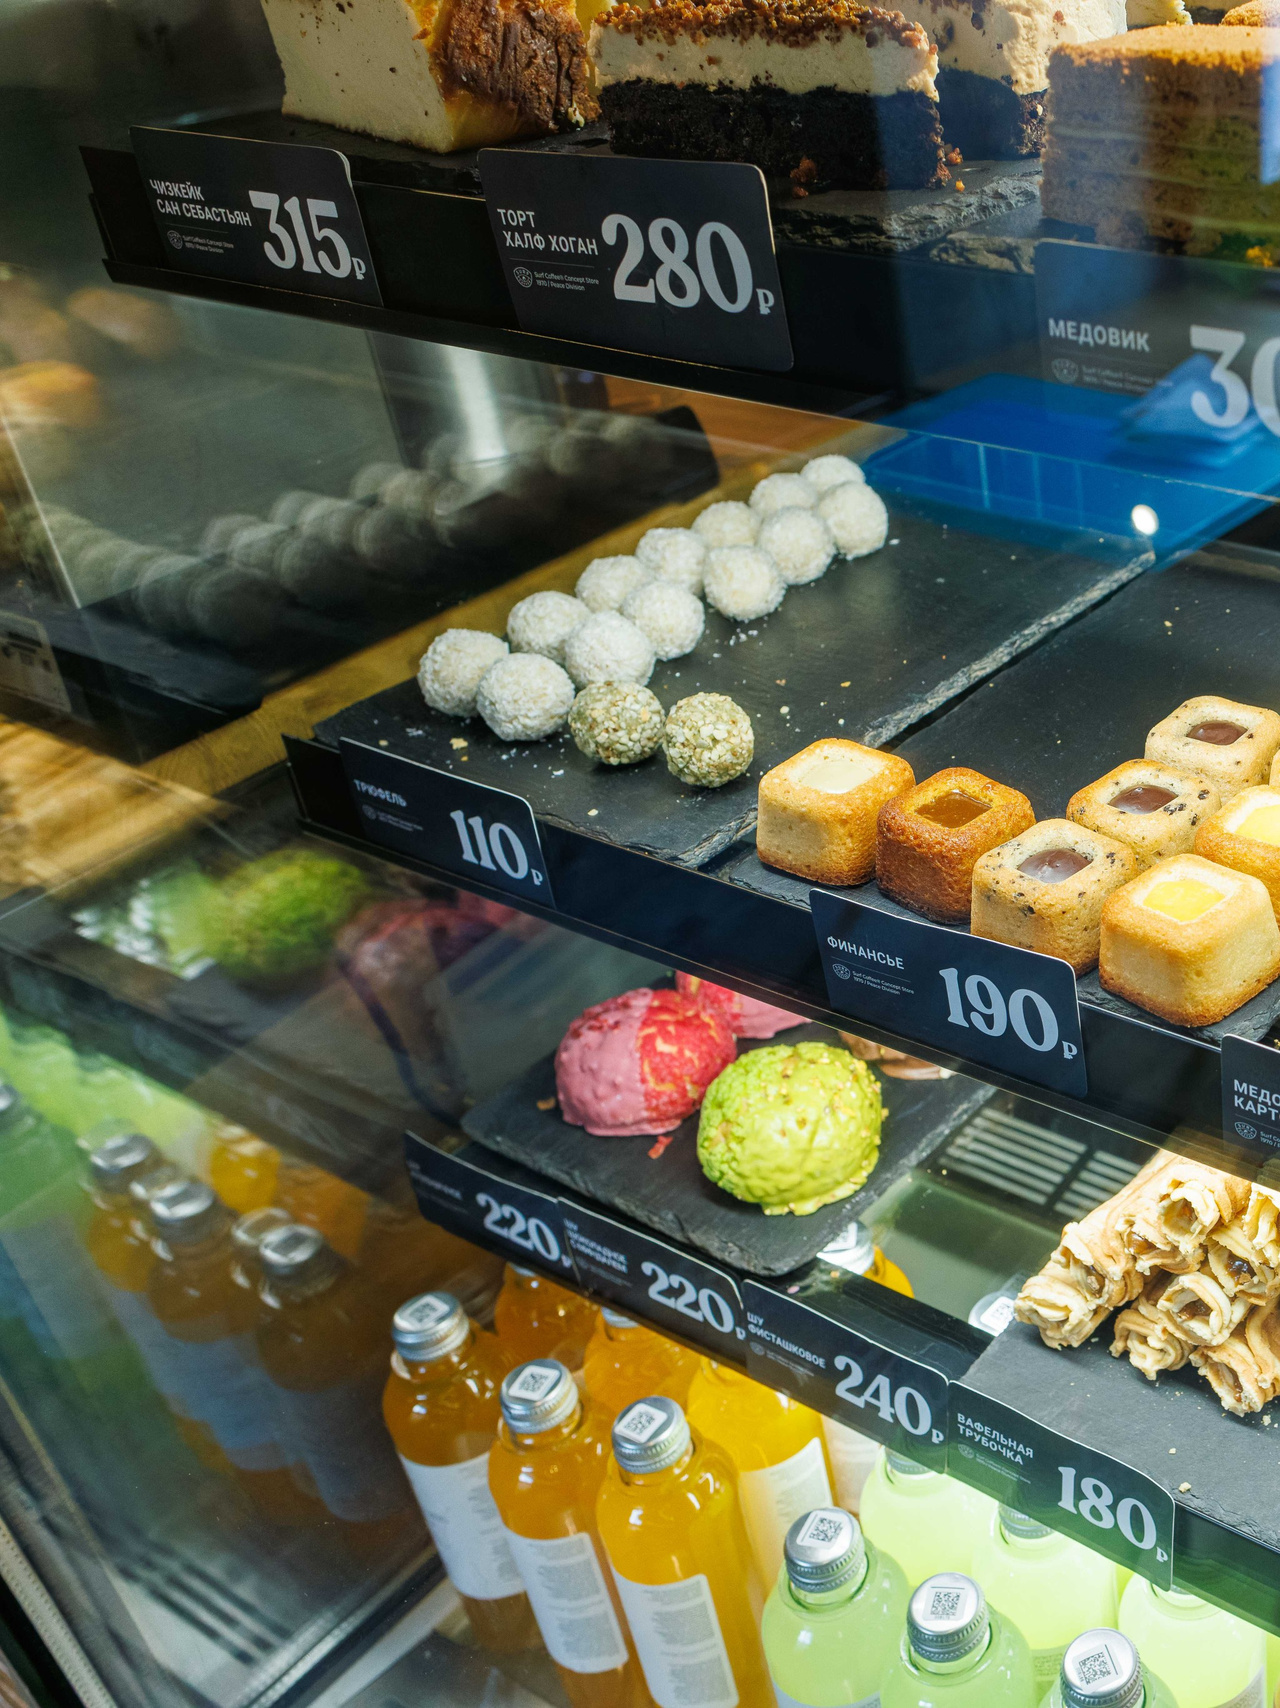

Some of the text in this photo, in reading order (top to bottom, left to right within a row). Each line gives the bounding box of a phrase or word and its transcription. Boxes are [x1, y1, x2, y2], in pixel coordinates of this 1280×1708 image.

[149, 179, 205, 201] ЧИЗКЕЙК
[157, 199, 252, 227] САН СЕБАСТЬЯН
[497, 208, 535, 228] ТОРТ
[502, 230, 598, 255] ХАЛФ ХОГАН
[1048, 318, 1150, 352] МЕДОВИК
[353, 778, 408, 807] ТРЮФЕЛЬ
[827, 935, 905, 970] ФИНАНСЬЕ
[747, 1323, 826, 1369] ФИСТАШКОВОЕ
[957, 1412, 1034, 1458] ВАФЕЛЬНАЯ
[957, 1423, 1024, 1465] ТРУБОЧКА
